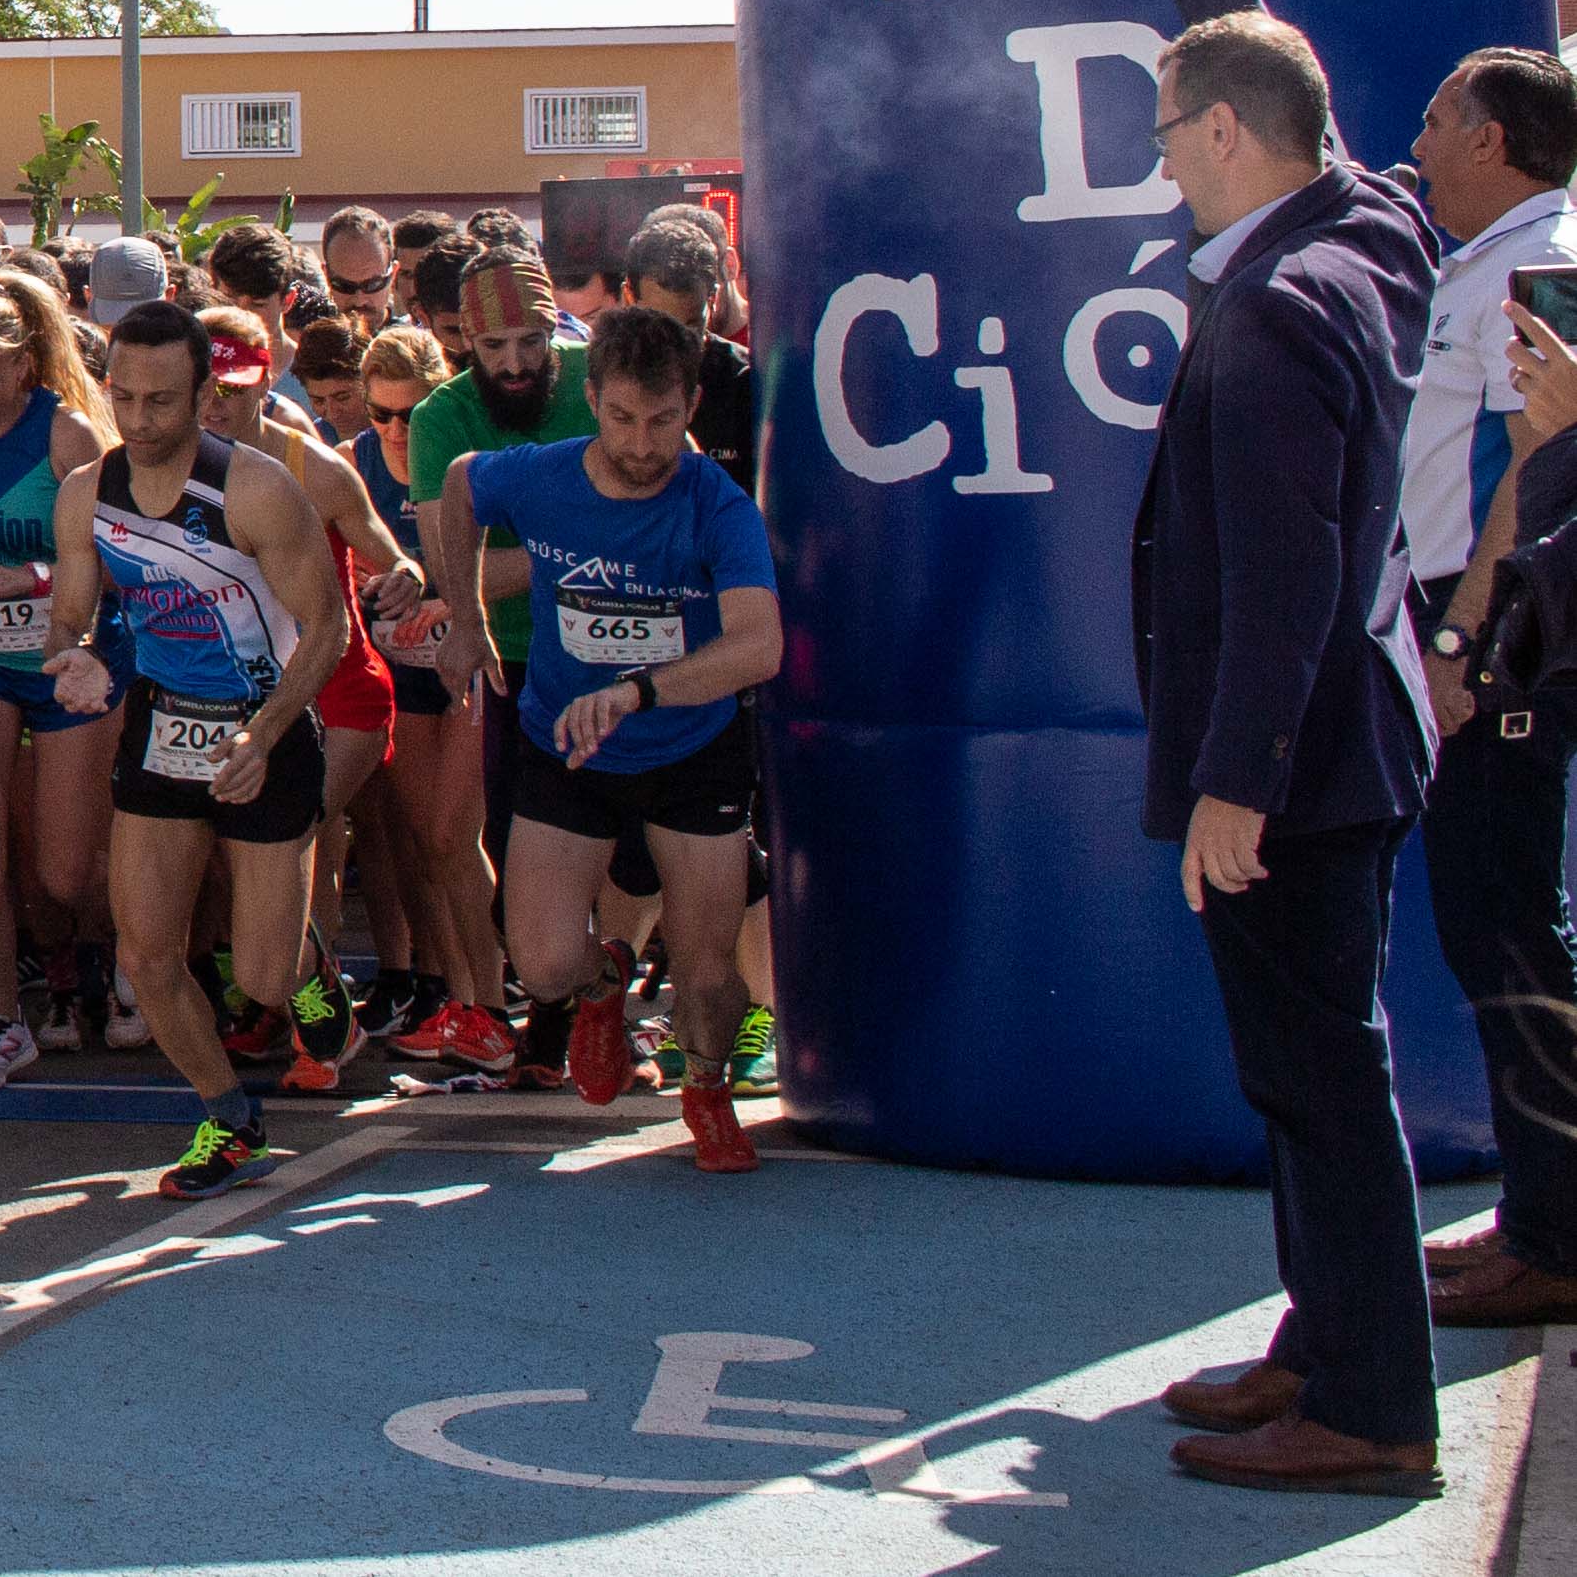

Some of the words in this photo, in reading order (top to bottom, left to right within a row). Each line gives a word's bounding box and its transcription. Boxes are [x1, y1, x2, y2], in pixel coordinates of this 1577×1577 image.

[1006, 21, 1185, 222] D
[625, 582, 644, 595] EN
[647, 583, 666, 597] LA
[587, 617, 651, 640] 665
[168, 719, 226, 749] 204
